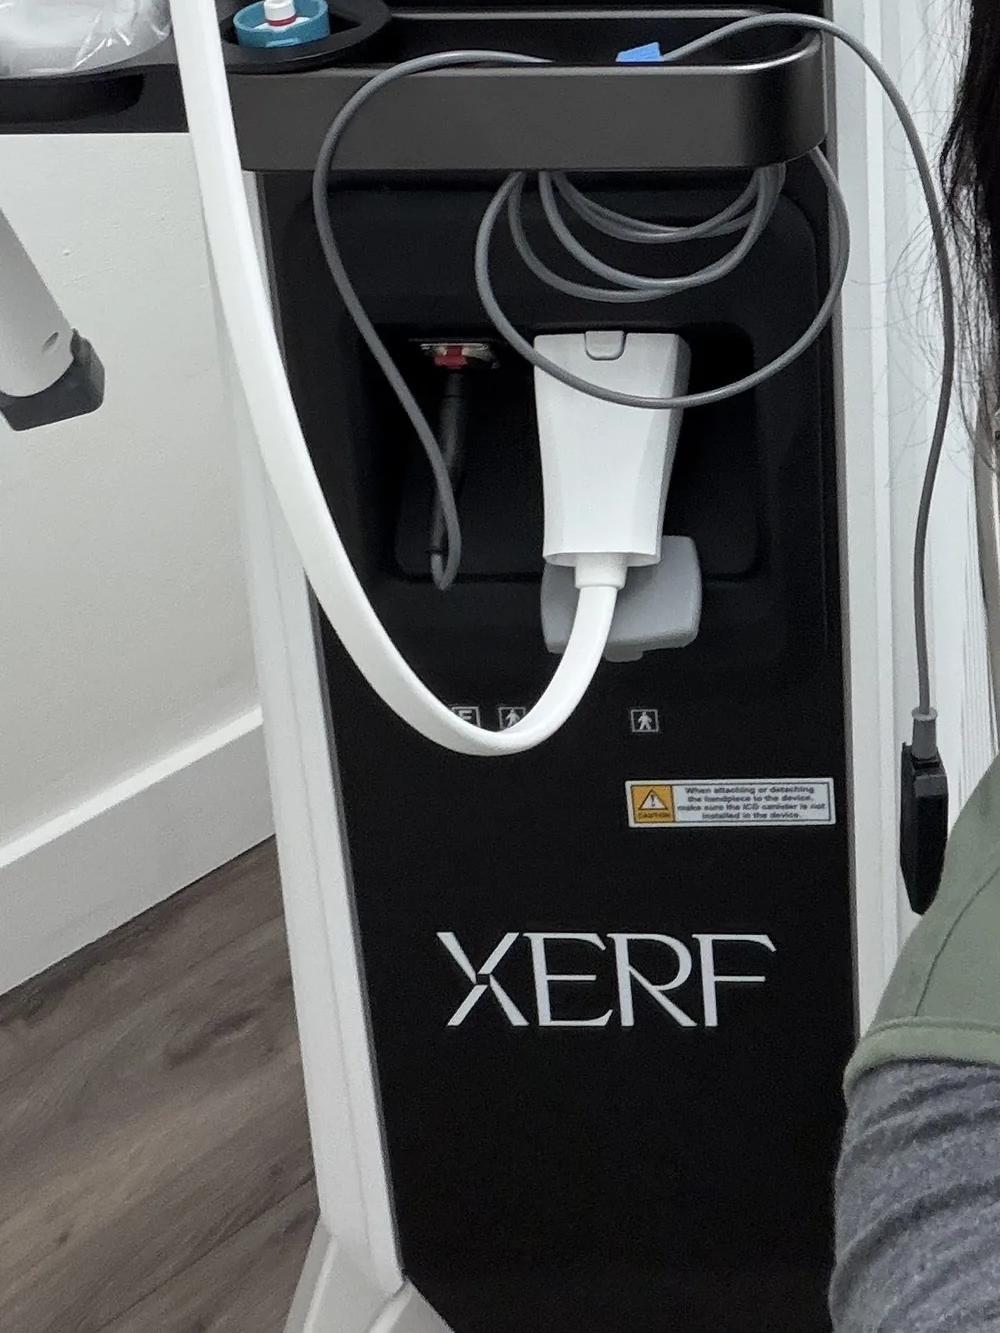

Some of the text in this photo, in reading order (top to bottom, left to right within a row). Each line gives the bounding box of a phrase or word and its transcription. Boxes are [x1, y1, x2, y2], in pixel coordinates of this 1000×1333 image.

[713, 786, 756, 795] attaching
[769, 786, 815, 794] detaching
[436, 931, 776, 1027] XERF
